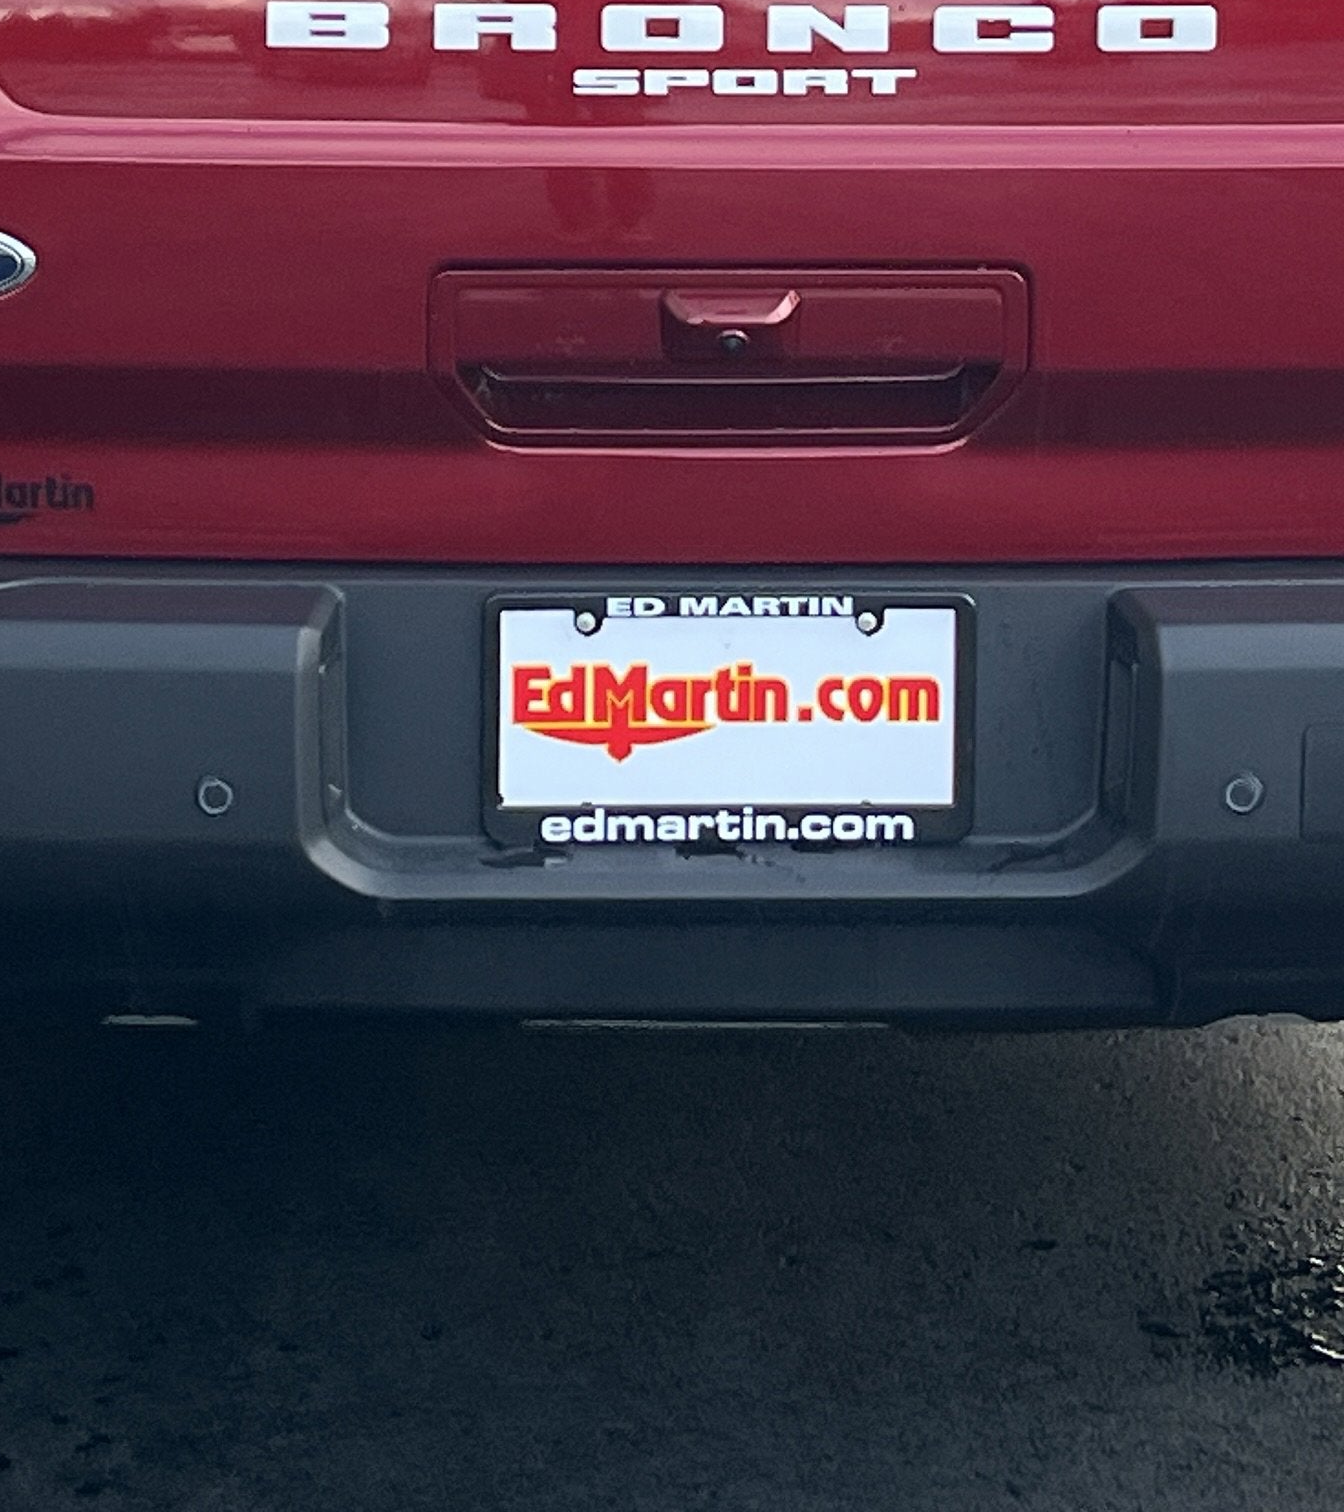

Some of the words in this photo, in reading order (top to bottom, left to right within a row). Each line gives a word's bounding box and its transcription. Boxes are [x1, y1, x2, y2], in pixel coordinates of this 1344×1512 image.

[264, 0, 1219, 54] BRONCO
[571, 68, 917, 96] SPORT
[606, 597, 665, 617] ED
[679, 597, 853, 617] MARTIN
[512, 663, 940, 723] EdMartin.com
[540, 808, 915, 843] edmartin.com
